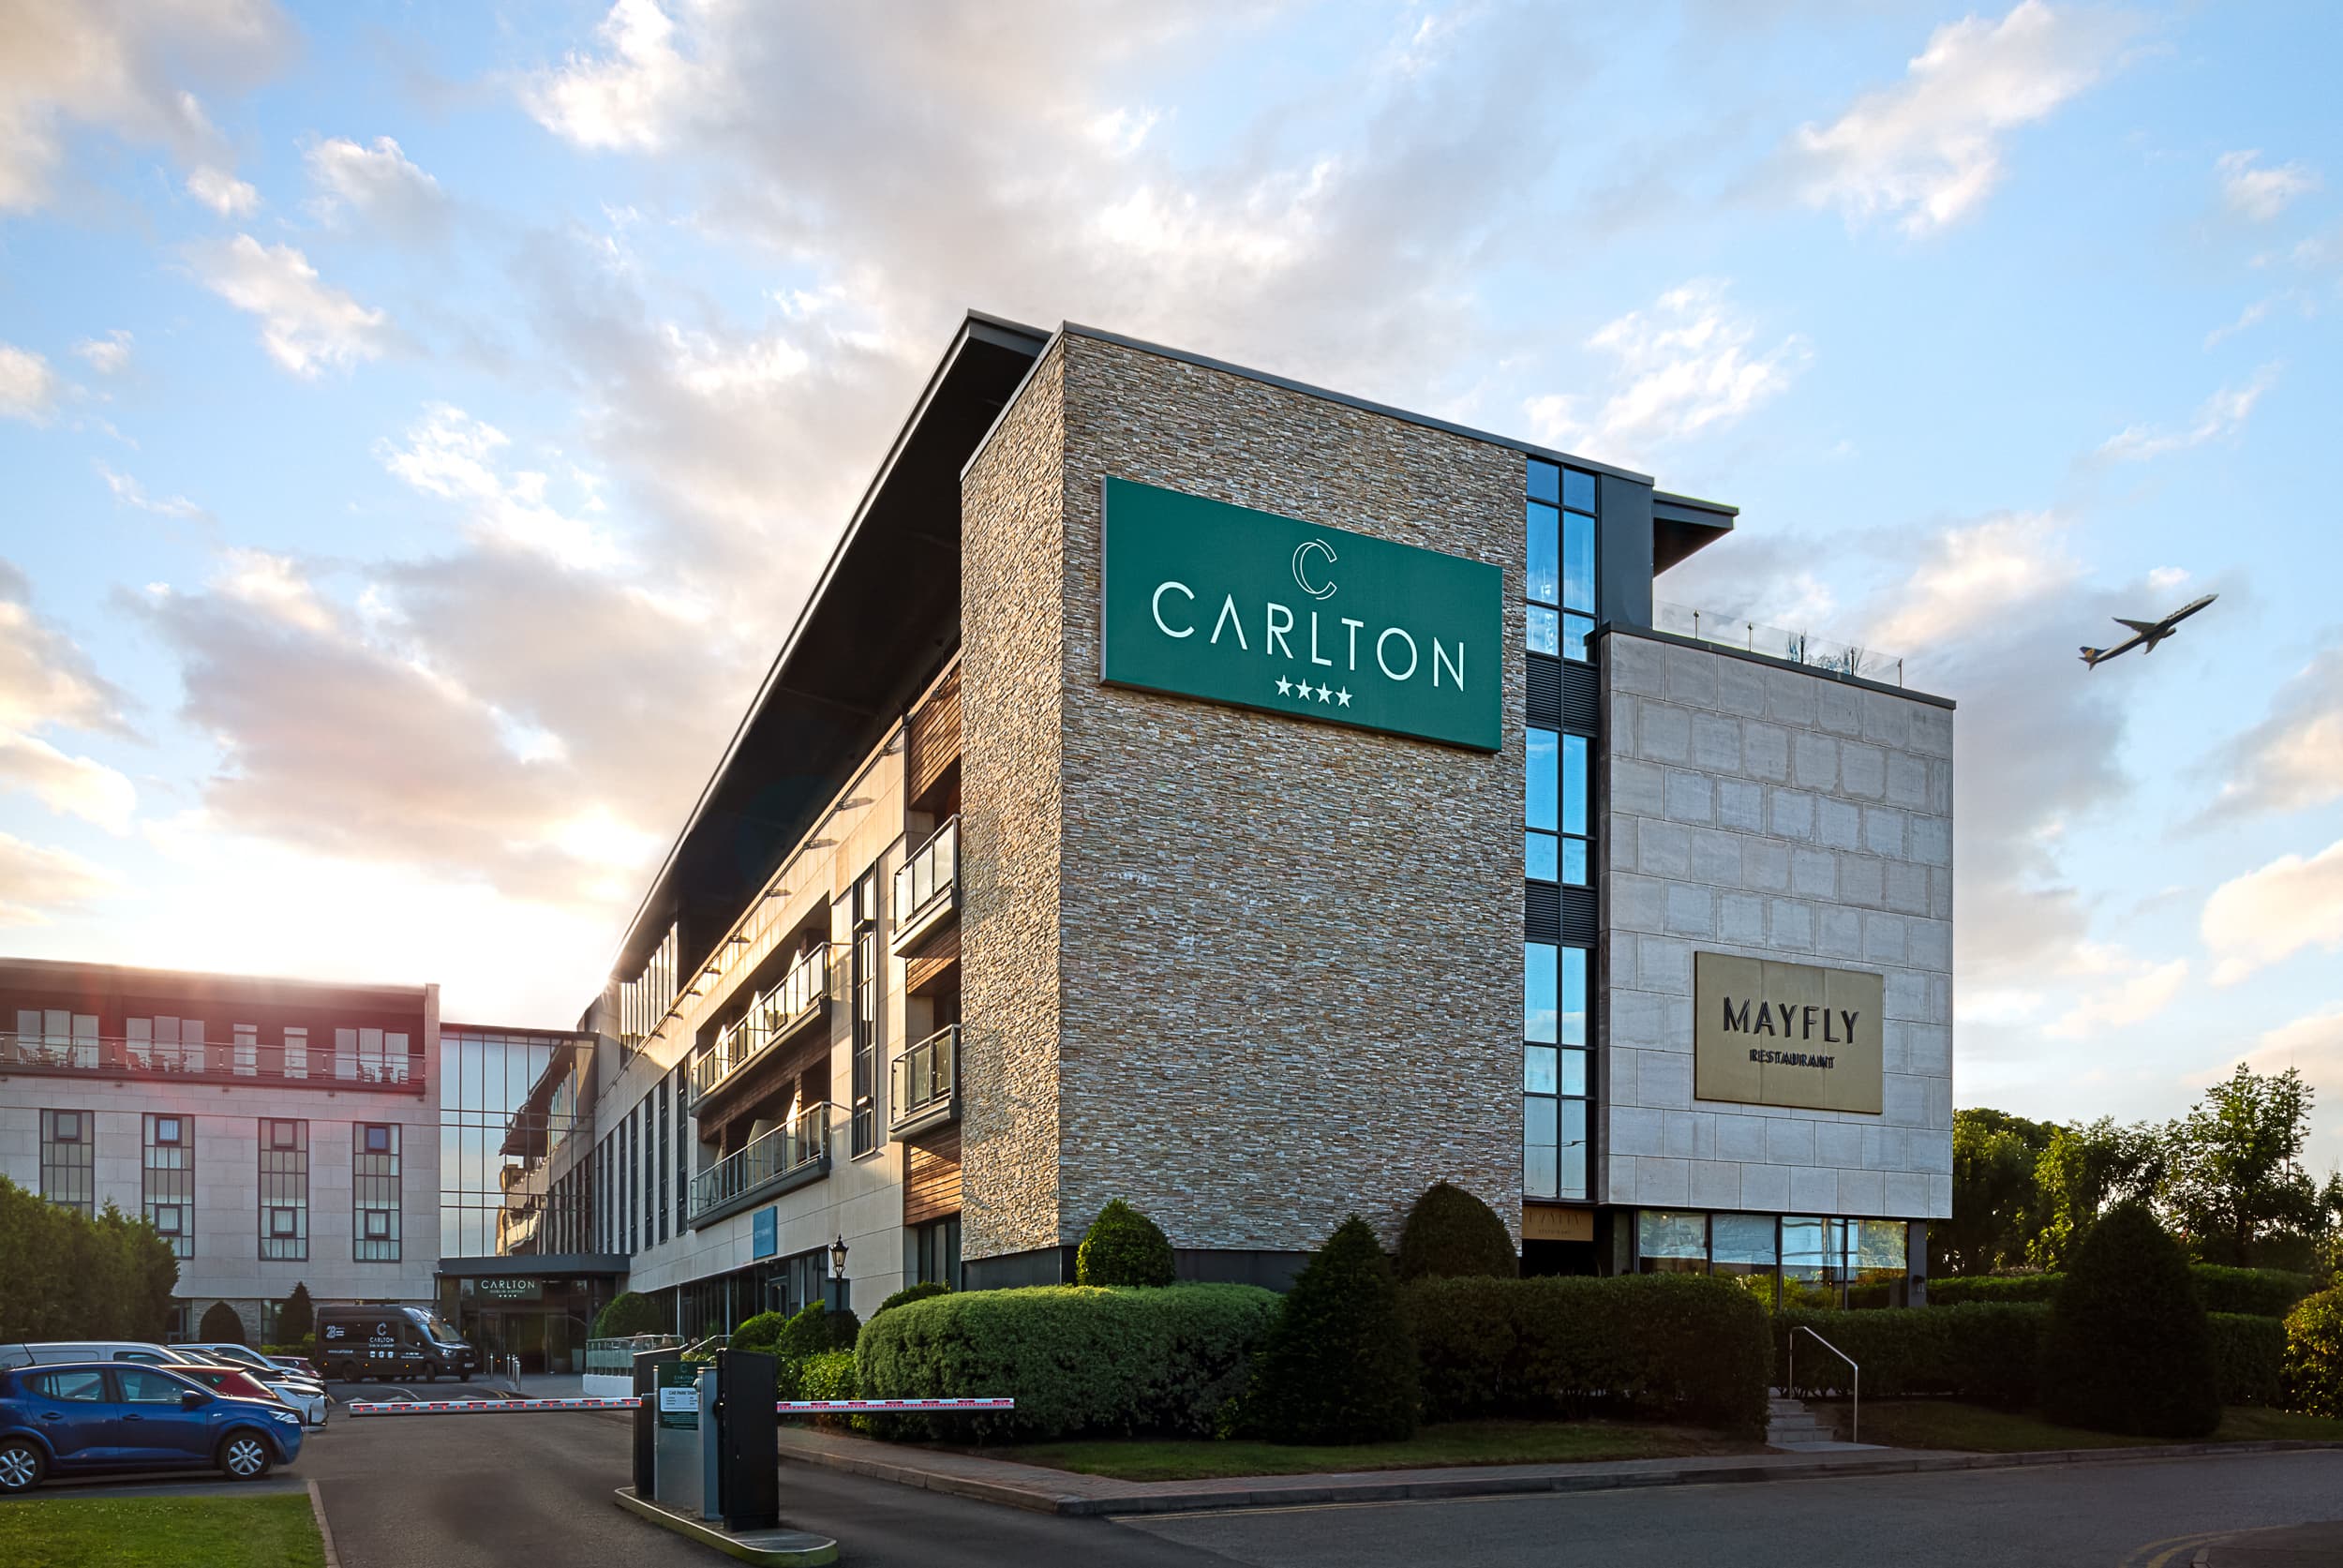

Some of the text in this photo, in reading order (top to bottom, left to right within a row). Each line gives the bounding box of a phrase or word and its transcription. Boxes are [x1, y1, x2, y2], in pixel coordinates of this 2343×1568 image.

[1152, 581, 1464, 692] CARLTON
[1724, 996, 1859, 1044] MAYFLY
[1750, 1049, 1835, 1069] RESTAURANT
[481, 1280, 535, 1290] CARLTON
